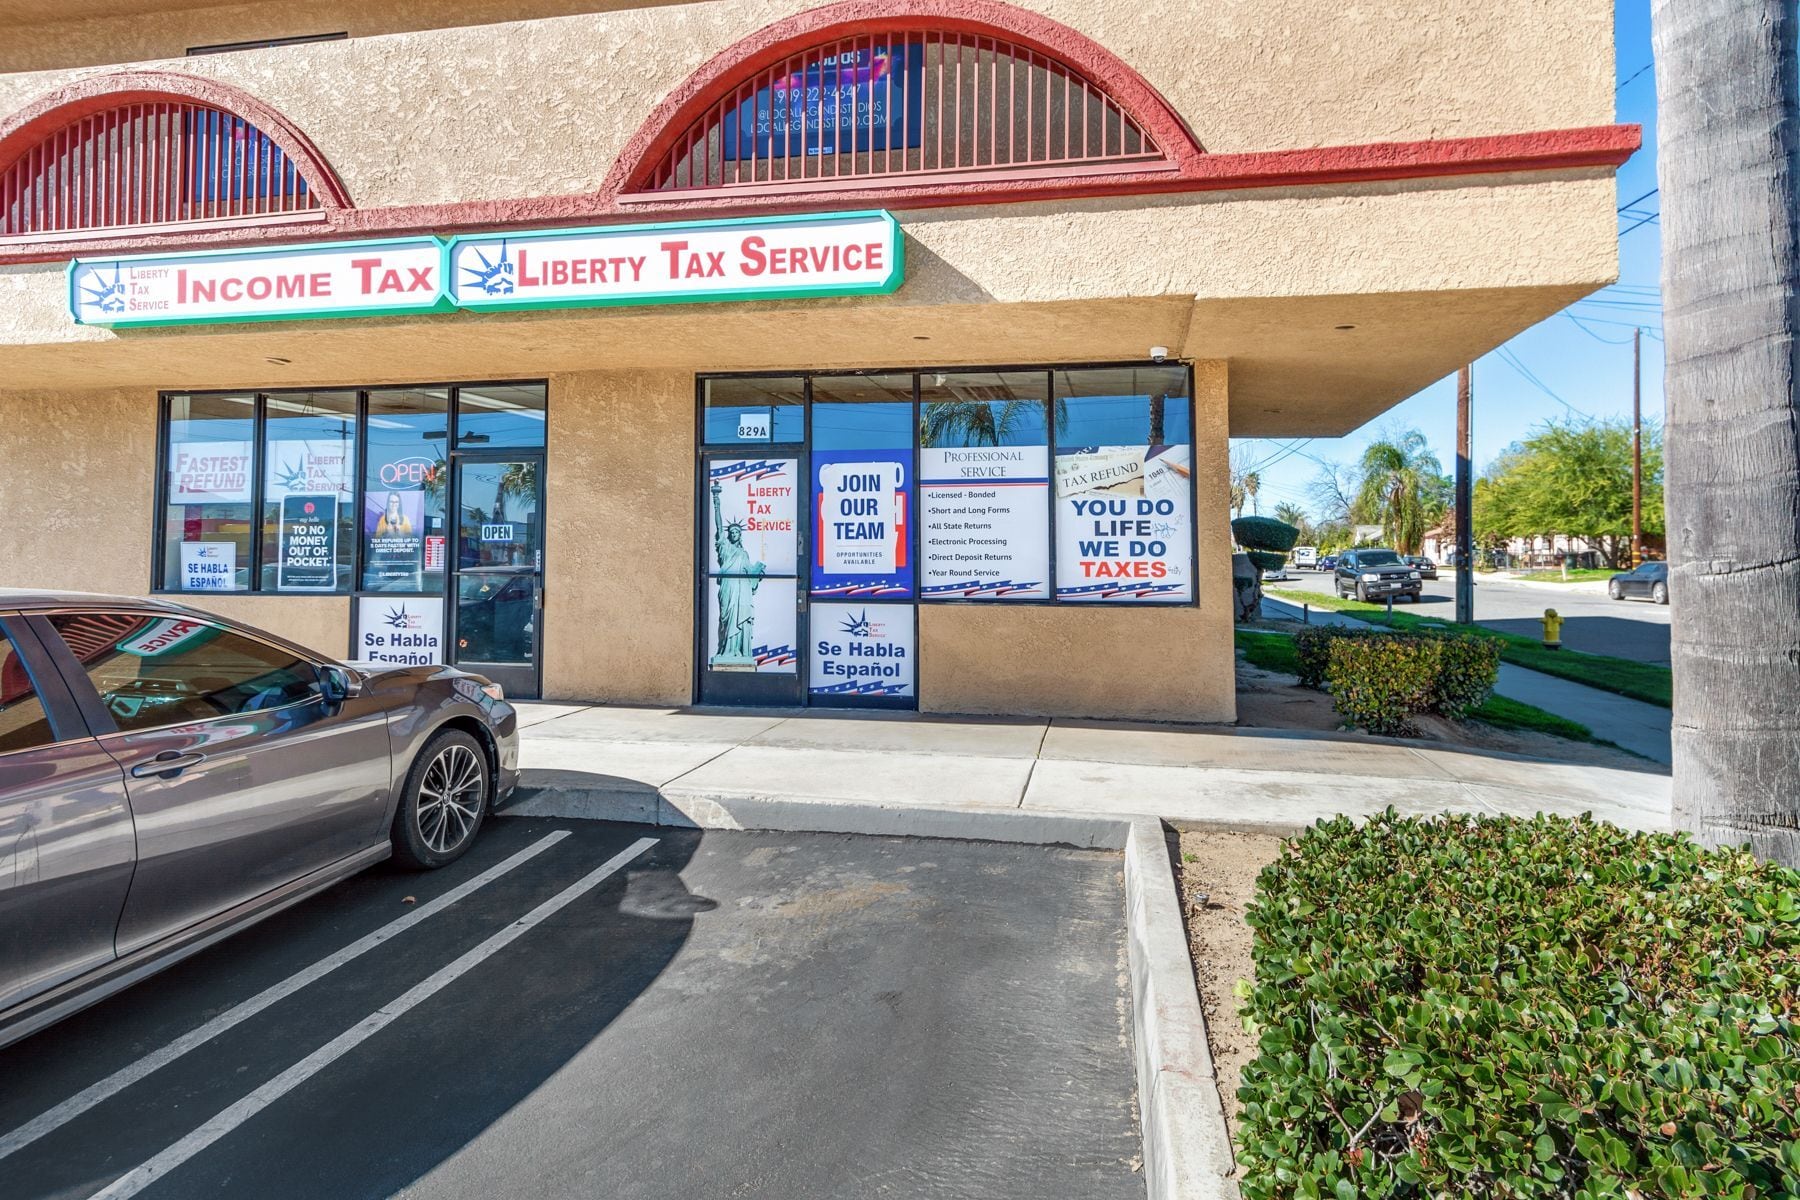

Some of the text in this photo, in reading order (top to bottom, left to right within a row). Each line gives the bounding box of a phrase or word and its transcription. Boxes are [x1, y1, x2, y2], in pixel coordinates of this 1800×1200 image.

[518, 236, 884, 287] LIBERTY TAX SERVICE
[130, 266, 169, 280] LIBERTY
[130, 282, 150, 295] TAX
[177, 258, 435, 305] INCOME TAX
[129, 297, 169, 311] SERVICE
[738, 426, 768, 437] 829A
[176, 453, 249, 473] FASTEST
[306, 453, 346, 465] LIBERTY
[944, 451, 1024, 463] PROFESSIONAL
[306, 466, 326, 478] TAX
[380, 463, 436, 482] OPEN
[961, 466, 1007, 477] SERVICE
[1062, 462, 1139, 488] TAX REFUND
[1148, 468, 1164, 480] 1040
[178, 472, 246, 493] REFUND
[306, 480, 347, 492] SERVICE
[837, 474, 880, 492] JOIN
[748, 483, 792, 497] LIBERTY
[931, 491, 962, 499] Licensed
[747, 500, 772, 514] TAX
[840, 498, 878, 516] OUR
[968, 507, 986, 515] Long
[1071, 499, 1174, 516] YOU DO
[292, 525, 325, 535] TO NO
[747, 517, 792, 531] SERVICE
[833, 522, 884, 540] TEAM
[1094, 520, 1151, 536] LIFE
[484, 526, 511, 539] OPEN
[289, 536, 328, 546] MONEY
[968, 538, 1007, 546] Processing
[289, 546, 328, 556] OUT OF
[1079, 540, 1167, 557] WE DO
[955, 553, 982, 562] Deposit
[188, 563, 229, 574] SE HABLA
[1079, 561, 1167, 578] TAXES
[190, 575, 228, 588] ESPAÑOL
[365, 633, 438, 647] Se Habla
[818, 641, 906, 658] Se Habla
[823, 660, 900, 679] Español
